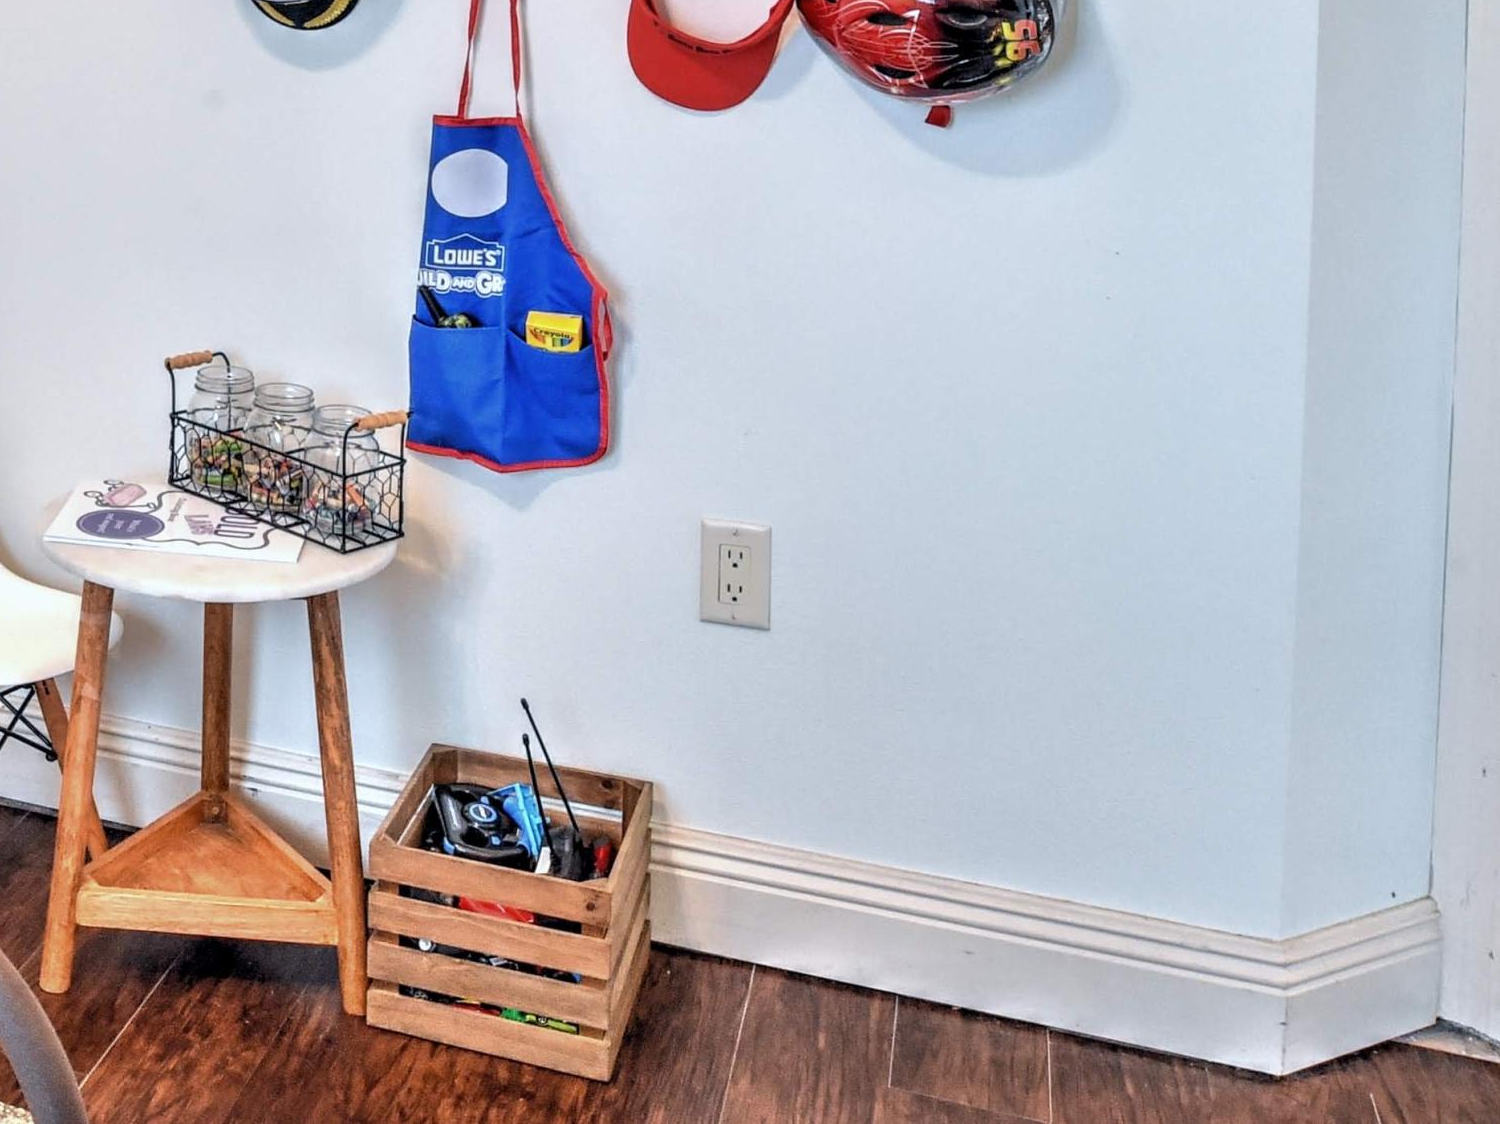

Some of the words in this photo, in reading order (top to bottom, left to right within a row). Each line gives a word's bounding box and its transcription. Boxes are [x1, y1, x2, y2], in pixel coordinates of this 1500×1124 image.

[433, 245, 497, 267] LOWE'S
[453, 277, 475, 289] AND
[533, 327, 571, 339] Crayola
